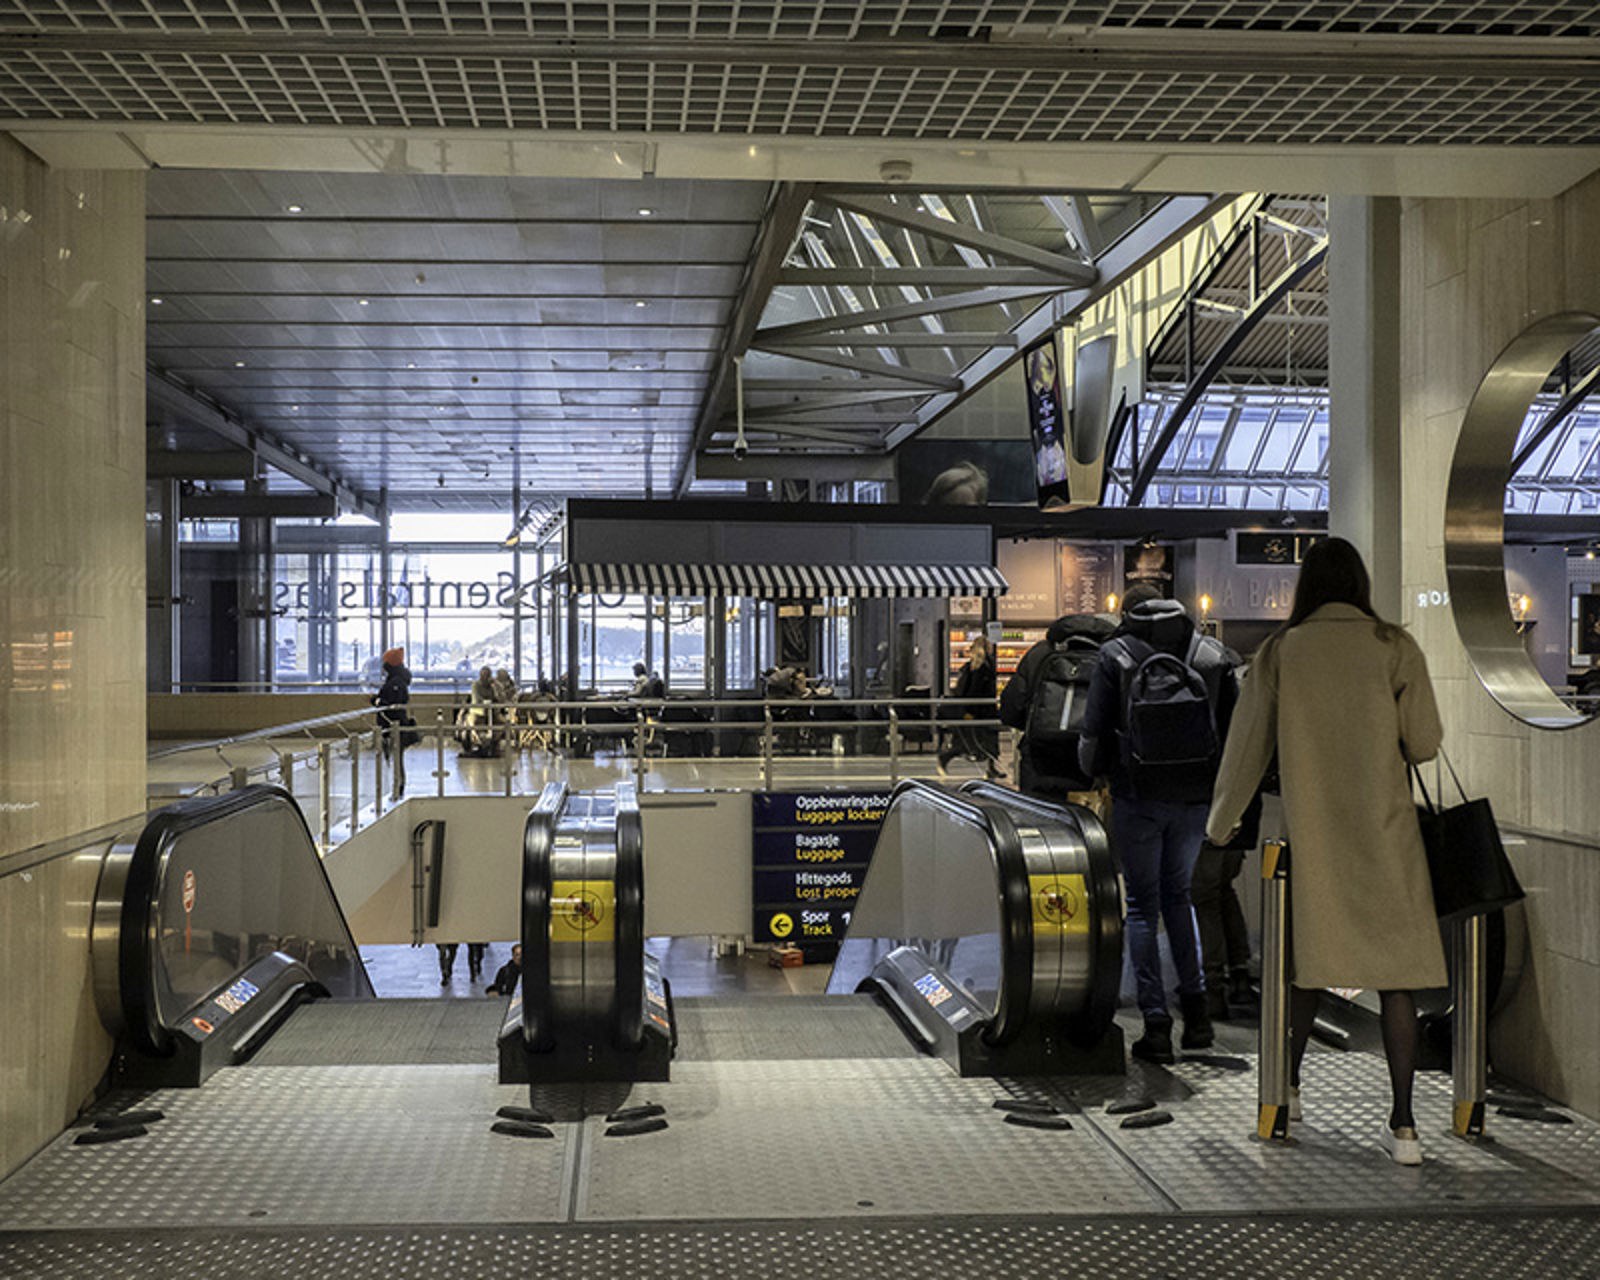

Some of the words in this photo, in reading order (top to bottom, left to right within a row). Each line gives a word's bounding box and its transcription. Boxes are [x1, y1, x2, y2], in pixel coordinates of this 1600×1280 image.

[796, 795, 892, 809] Oppbevaringsbo
[796, 810, 844, 823] Luggage
[796, 834, 839, 848] Bagasje
[796, 848, 844, 861] Luggage
[796, 872, 852, 886] Hittegods
[796, 887, 820, 898] Lost
[802, 909, 829, 924] Spor
[803, 924, 832, 936] Track
